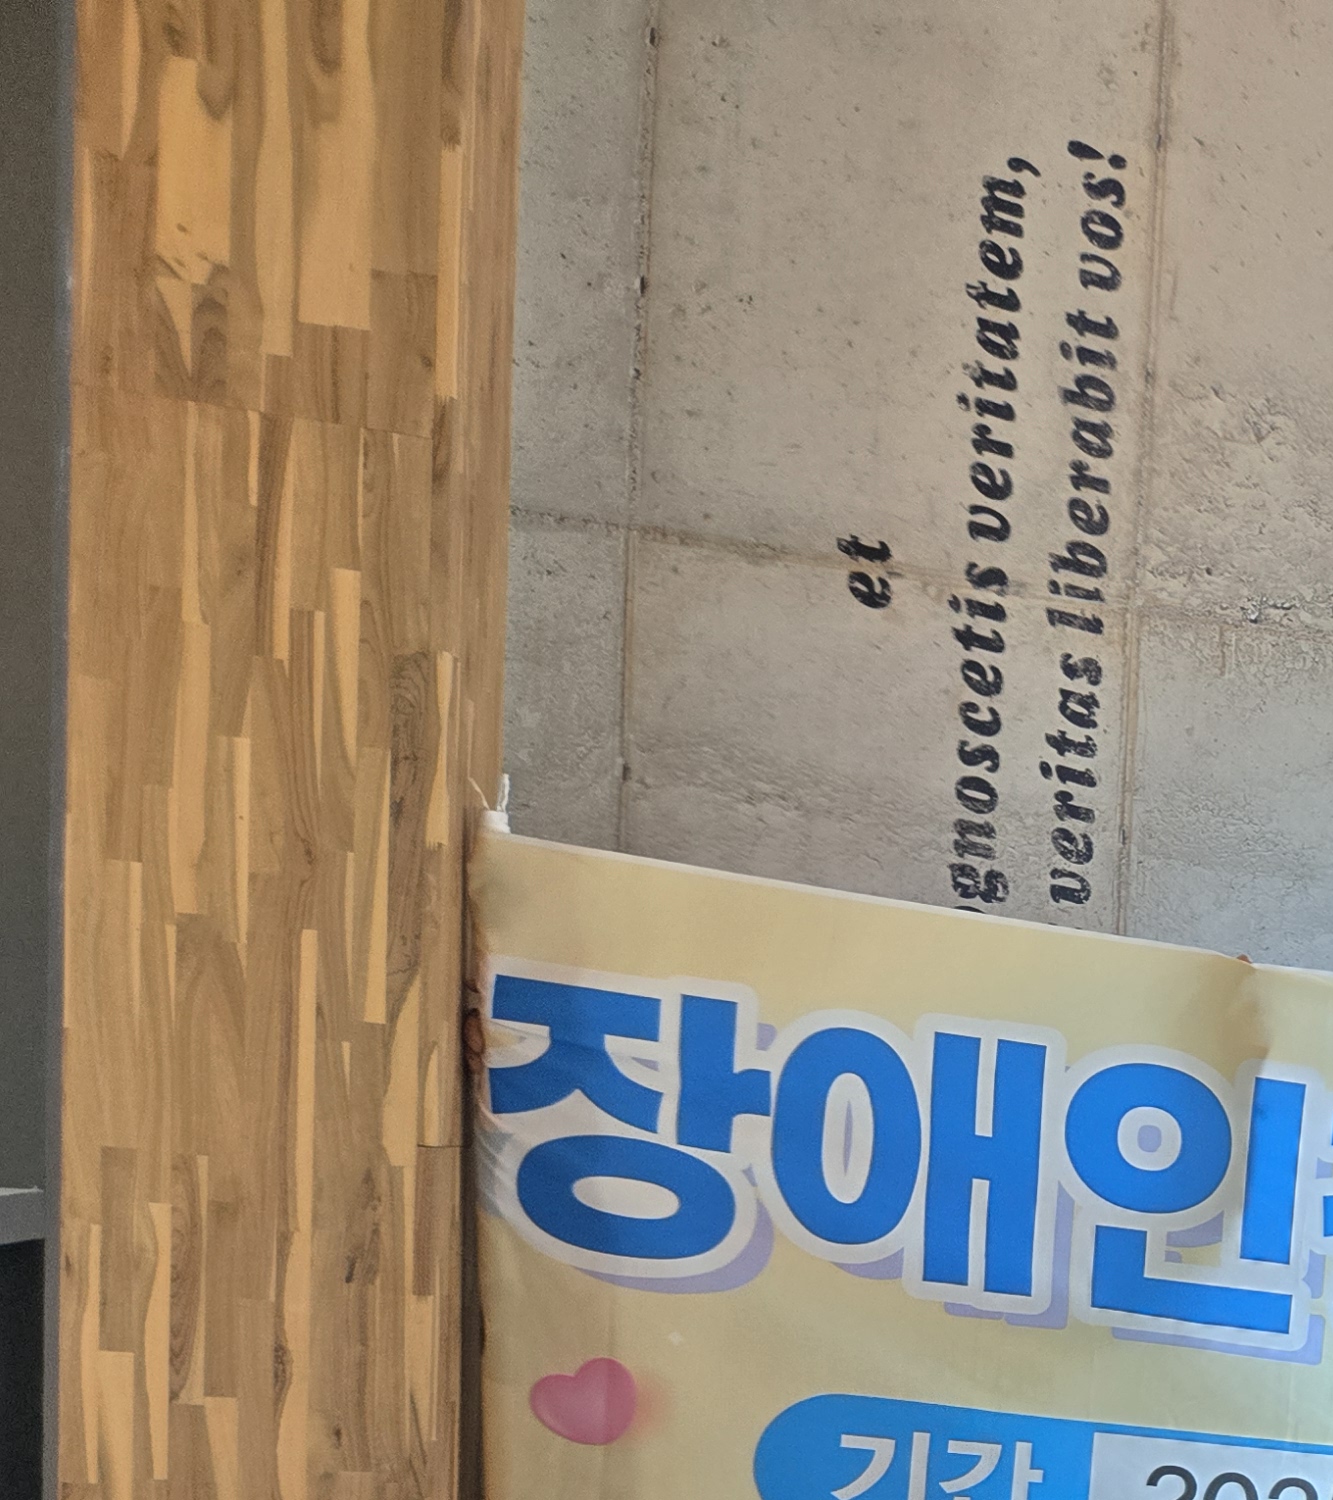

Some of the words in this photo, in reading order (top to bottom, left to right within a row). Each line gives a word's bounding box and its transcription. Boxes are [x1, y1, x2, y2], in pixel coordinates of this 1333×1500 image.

[956, 156, 1042, 543] veritatem,
[1066, 139, 1128, 293] vos!
[836, 533, 893, 610] et
[1047, 309, 1120, 636] liberabit
[946, 562, 1010, 913] gnoscetis
[1039, 651, 1103, 906] veritas
